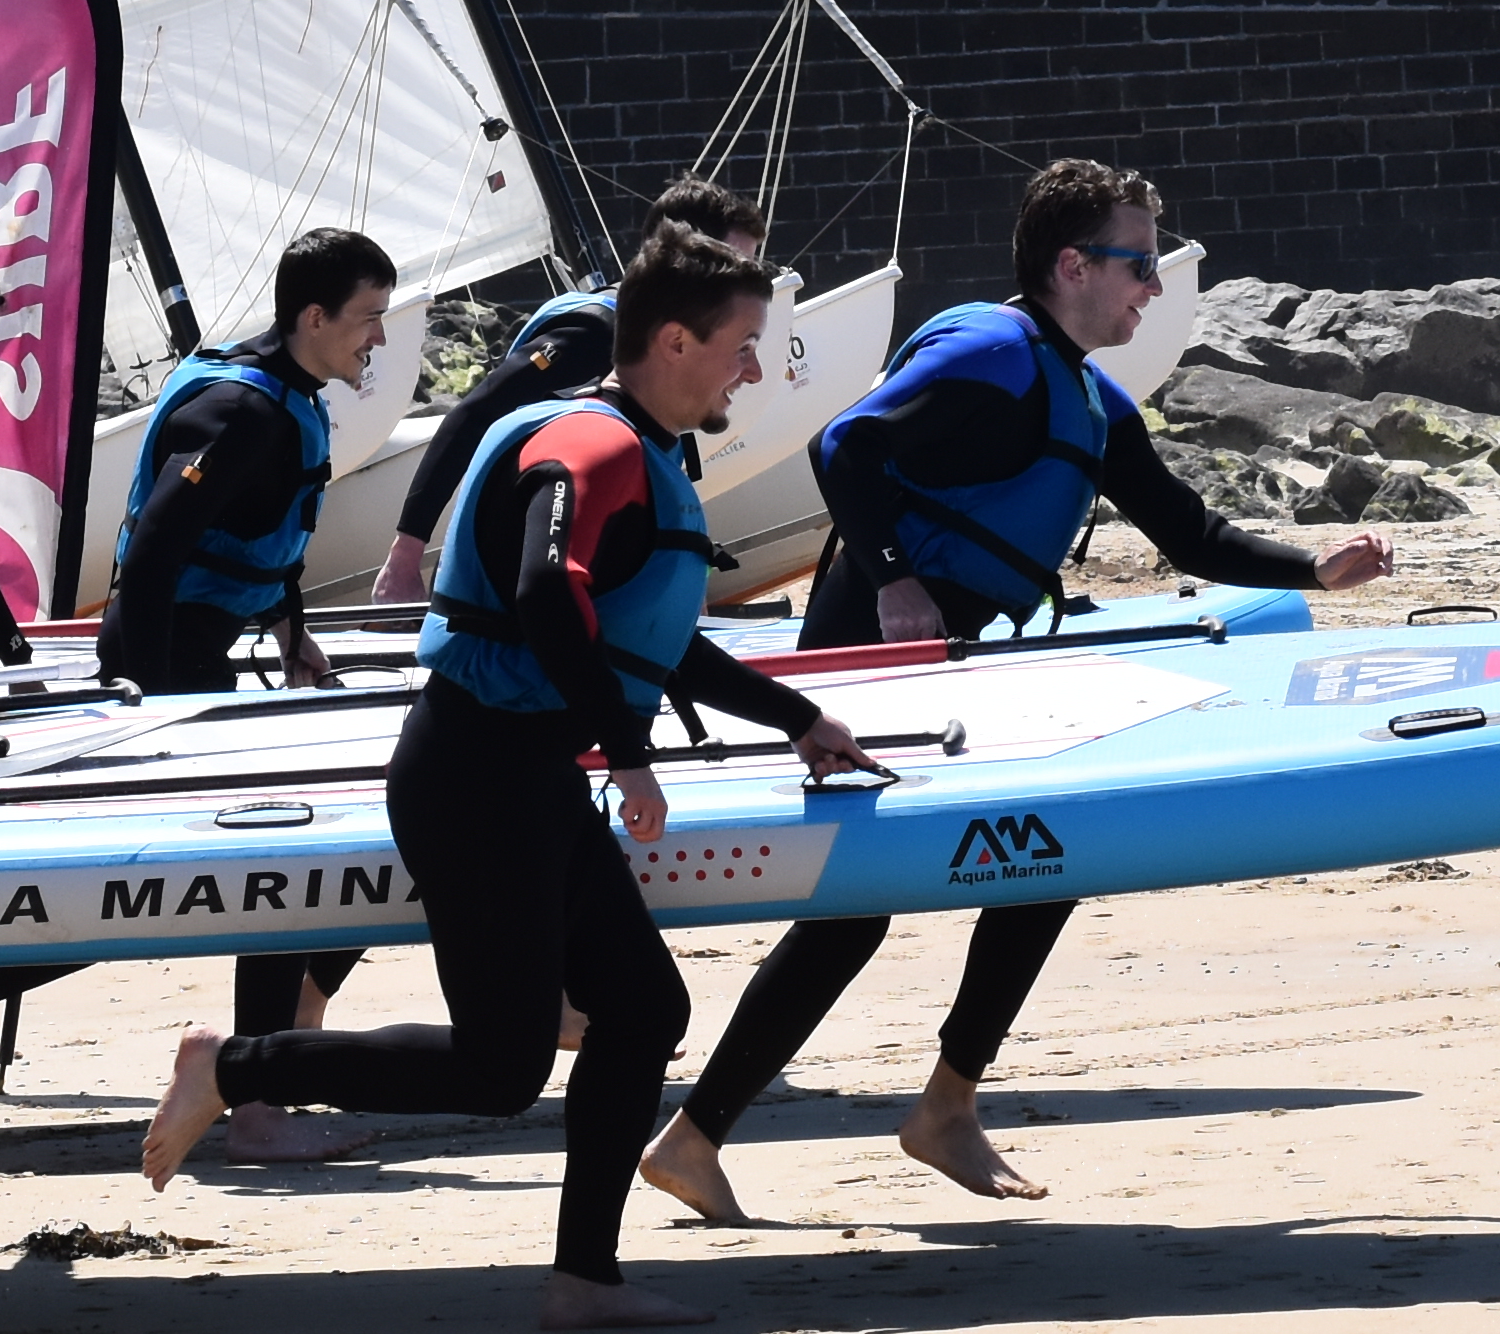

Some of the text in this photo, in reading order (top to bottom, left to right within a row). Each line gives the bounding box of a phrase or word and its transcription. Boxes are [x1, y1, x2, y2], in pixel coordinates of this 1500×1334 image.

[101, 865, 421, 920] MARIN
[948, 863, 1064, 886] Aqua Marina
